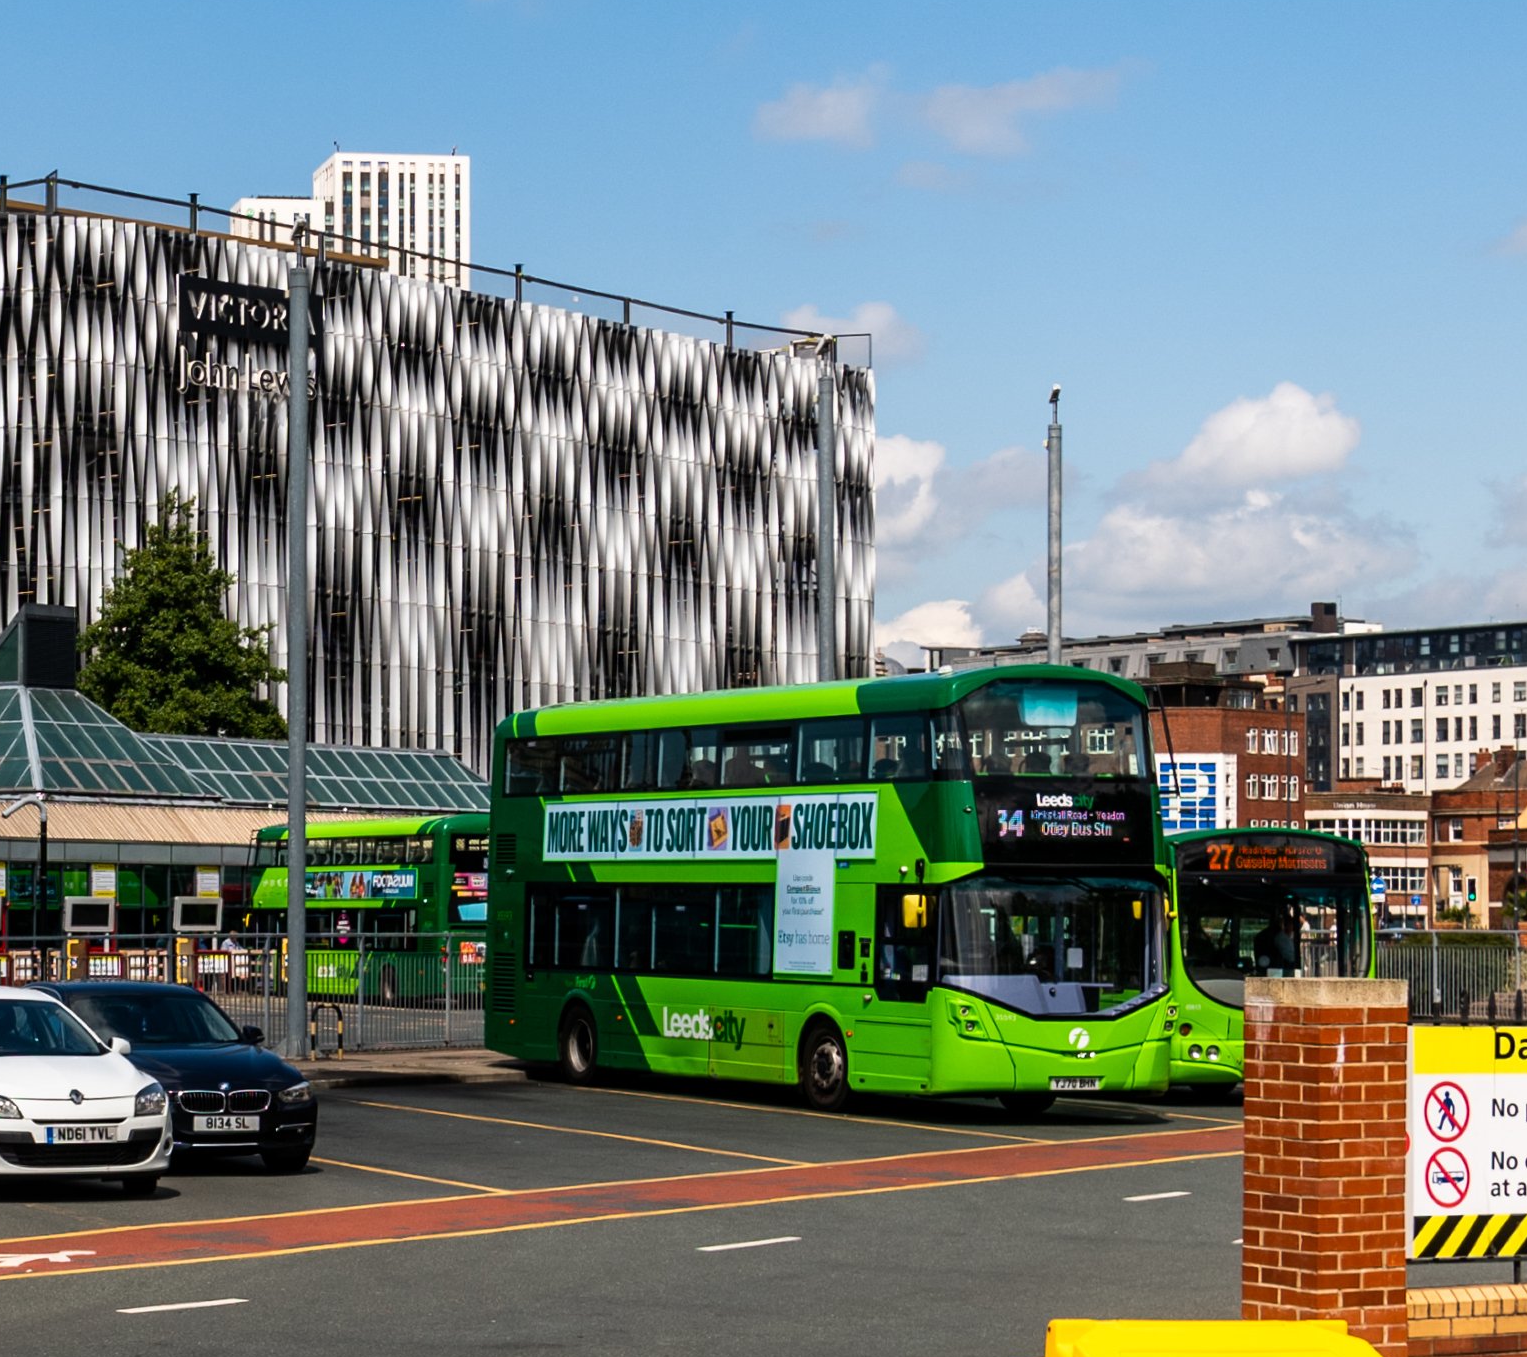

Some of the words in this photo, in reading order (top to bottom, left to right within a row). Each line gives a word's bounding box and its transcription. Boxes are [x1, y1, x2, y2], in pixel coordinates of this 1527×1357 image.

[187, 289, 316, 336] VICTOR
[177, 344, 240, 394] John
[547, 810, 585, 854] MORE
[587, 808, 629, 853] WAYS
[645, 808, 664, 853] TO
[665, 806, 708, 853] SORT
[730, 805, 774, 852] YOUR
[791, 801, 875, 851] SHOEBOX
[997, 809, 1025, 837] 34
[1071, 822, 1092, 837] Bus
[1093, 822, 1113, 837] Stn
[1206, 844, 1234, 871] 27
[778, 929, 795, 947] Etsy
[795, 929, 807, 944] has
[808, 929, 830, 945] home
[1491, 1097, 1519, 1117] No
[205, 1116, 232, 1130] 8134
[234, 1116, 250, 1130] SL
[57, 1126, 87, 1141] ND61
[89, 1125, 114, 1140] TVL
[1490, 1151, 1519, 1170] No
[1490, 1180, 1510, 1197] at
